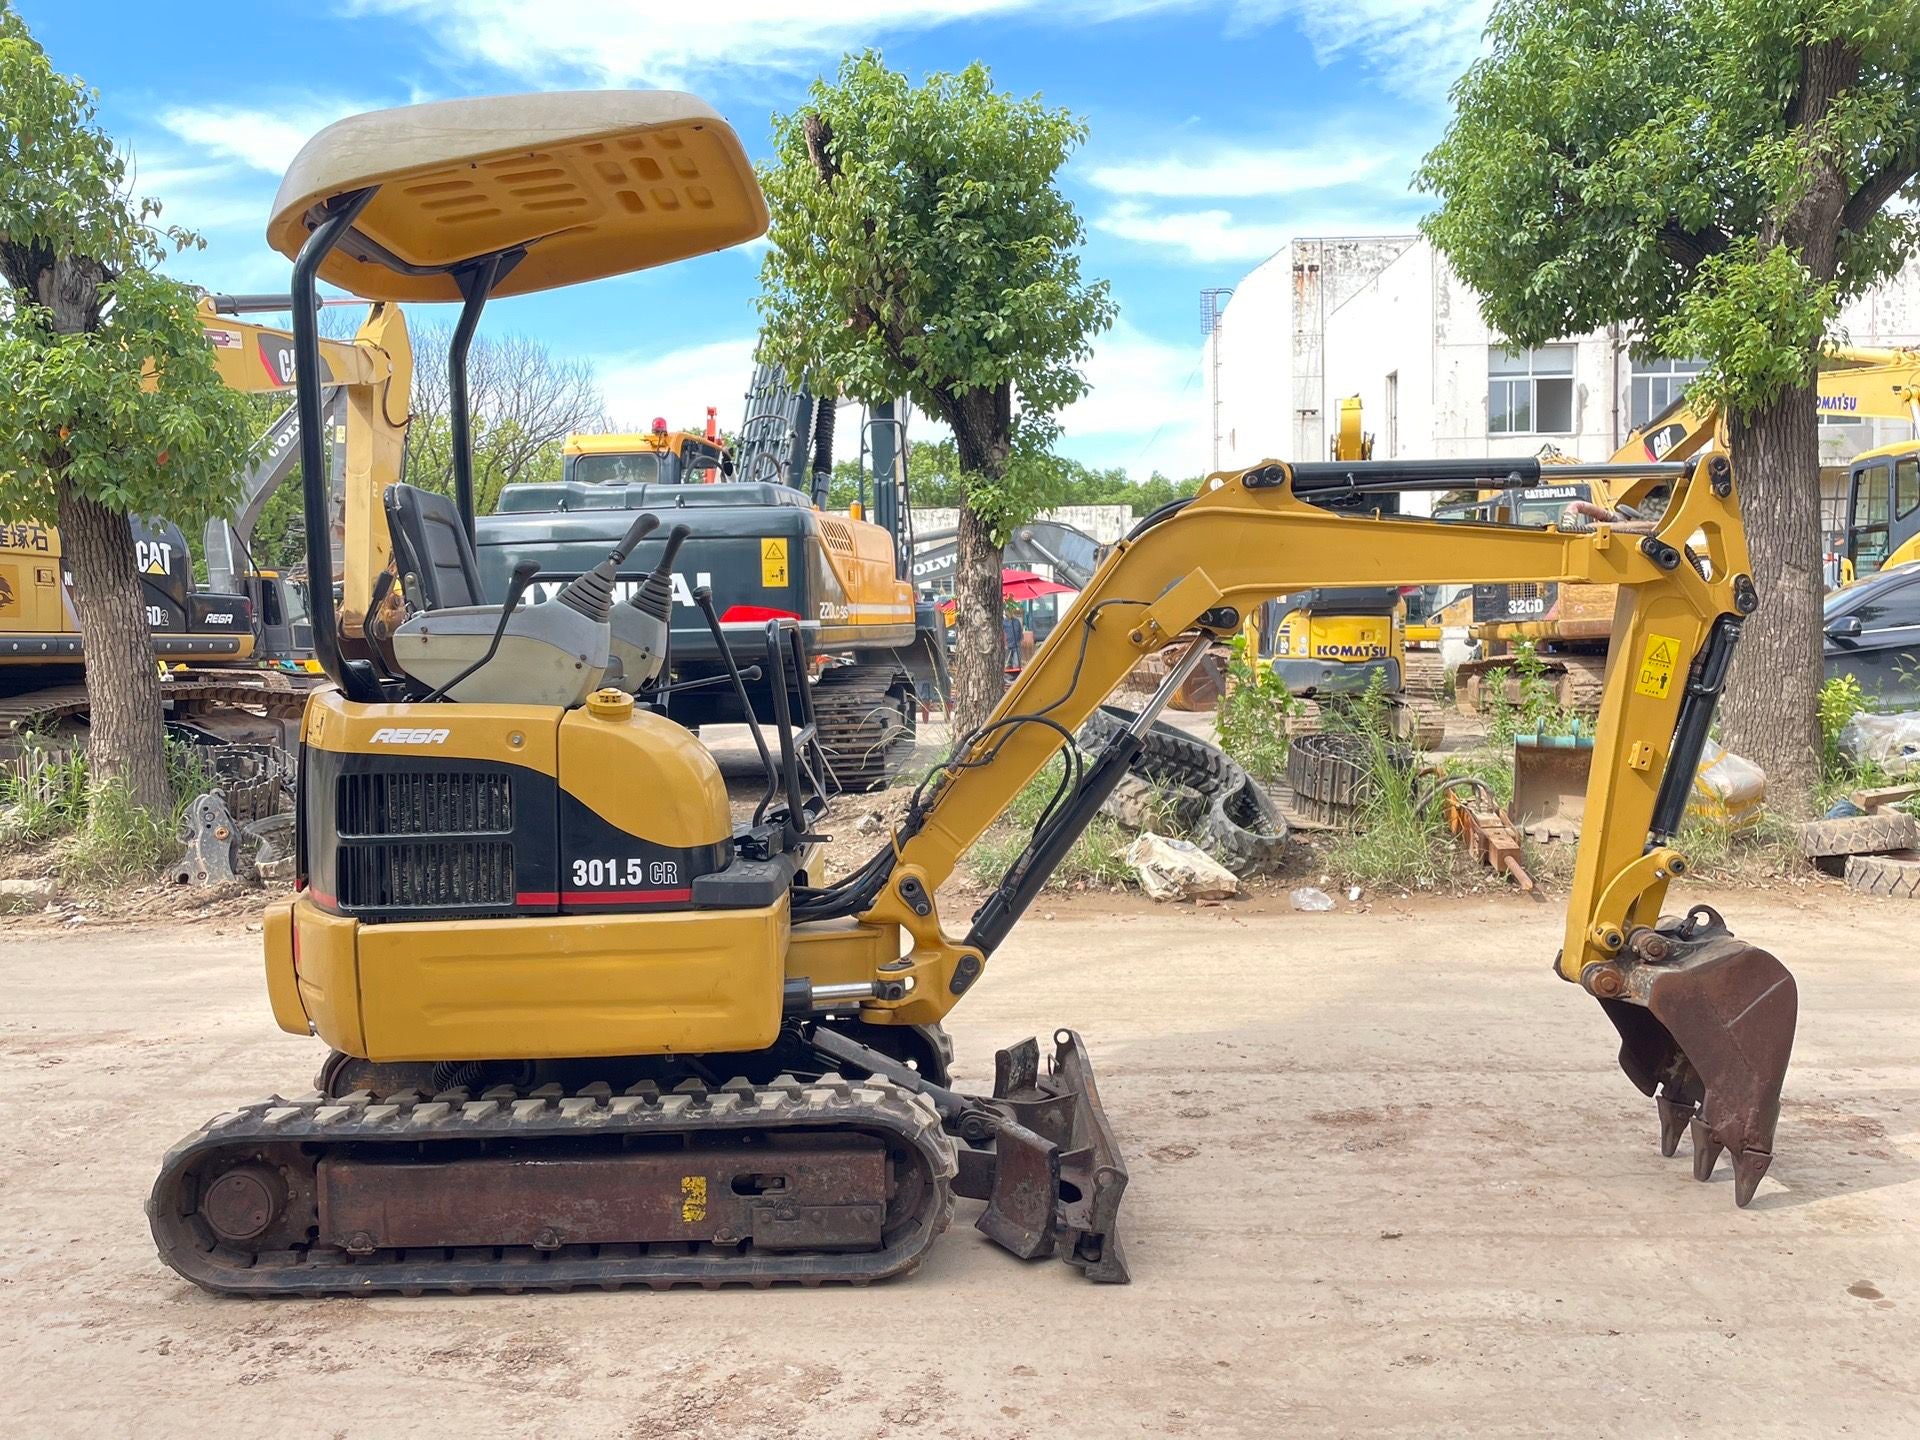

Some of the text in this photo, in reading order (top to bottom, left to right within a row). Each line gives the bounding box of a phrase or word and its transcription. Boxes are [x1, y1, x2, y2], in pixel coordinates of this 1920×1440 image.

[1817, 393, 1857, 411] OMATSU
[1653, 427, 1672, 460] CAT
[1524, 487, 1577, 499] CATERPILLAR
[135, 540, 172, 576] CAT
[913, 552, 957, 576] OLV
[204, 613, 233, 625] REGA
[1317, 644, 1387, 657] KOMATSU
[369, 728, 450, 744] REGA
[572, 858, 678, 887] 301.5 CR
